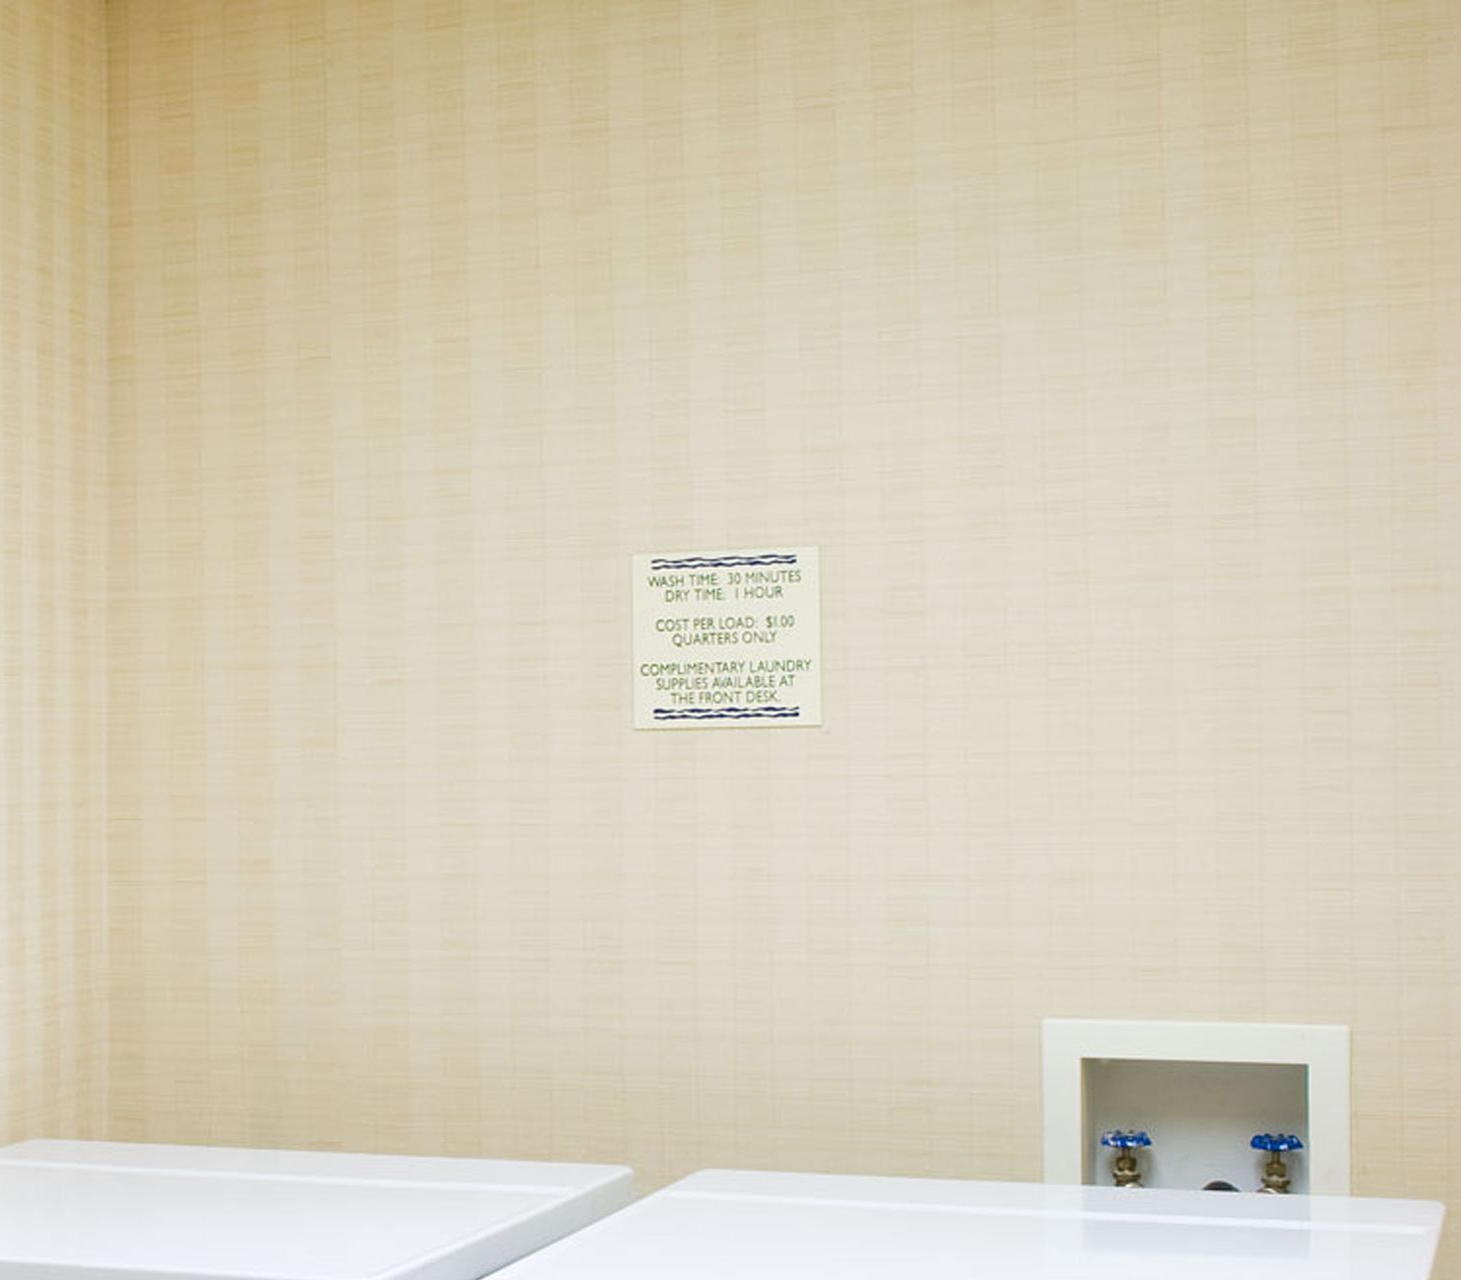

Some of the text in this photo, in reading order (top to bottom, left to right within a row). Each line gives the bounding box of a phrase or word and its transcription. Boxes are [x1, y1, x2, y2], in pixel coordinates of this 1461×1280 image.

[647, 575, 685, 588] WASH
[727, 573, 741, 585] 30
[745, 570, 802, 583] MINUTES
[665, 590, 690, 602] DRY
[744, 586, 784, 599] HOUR
[655, 619, 689, 632] COST
[693, 617, 714, 630] PER
[766, 615, 795, 628] $1.00
[671, 630, 778, 647] QUARTERS ONLY
[640, 659, 812, 676] COMPLIMENTARY LAUNDRY
[656, 674, 796, 691] SUPPLIES AVAILABLE AT
[671, 692, 696, 705] THE
[699, 691, 741, 704] FRONT
